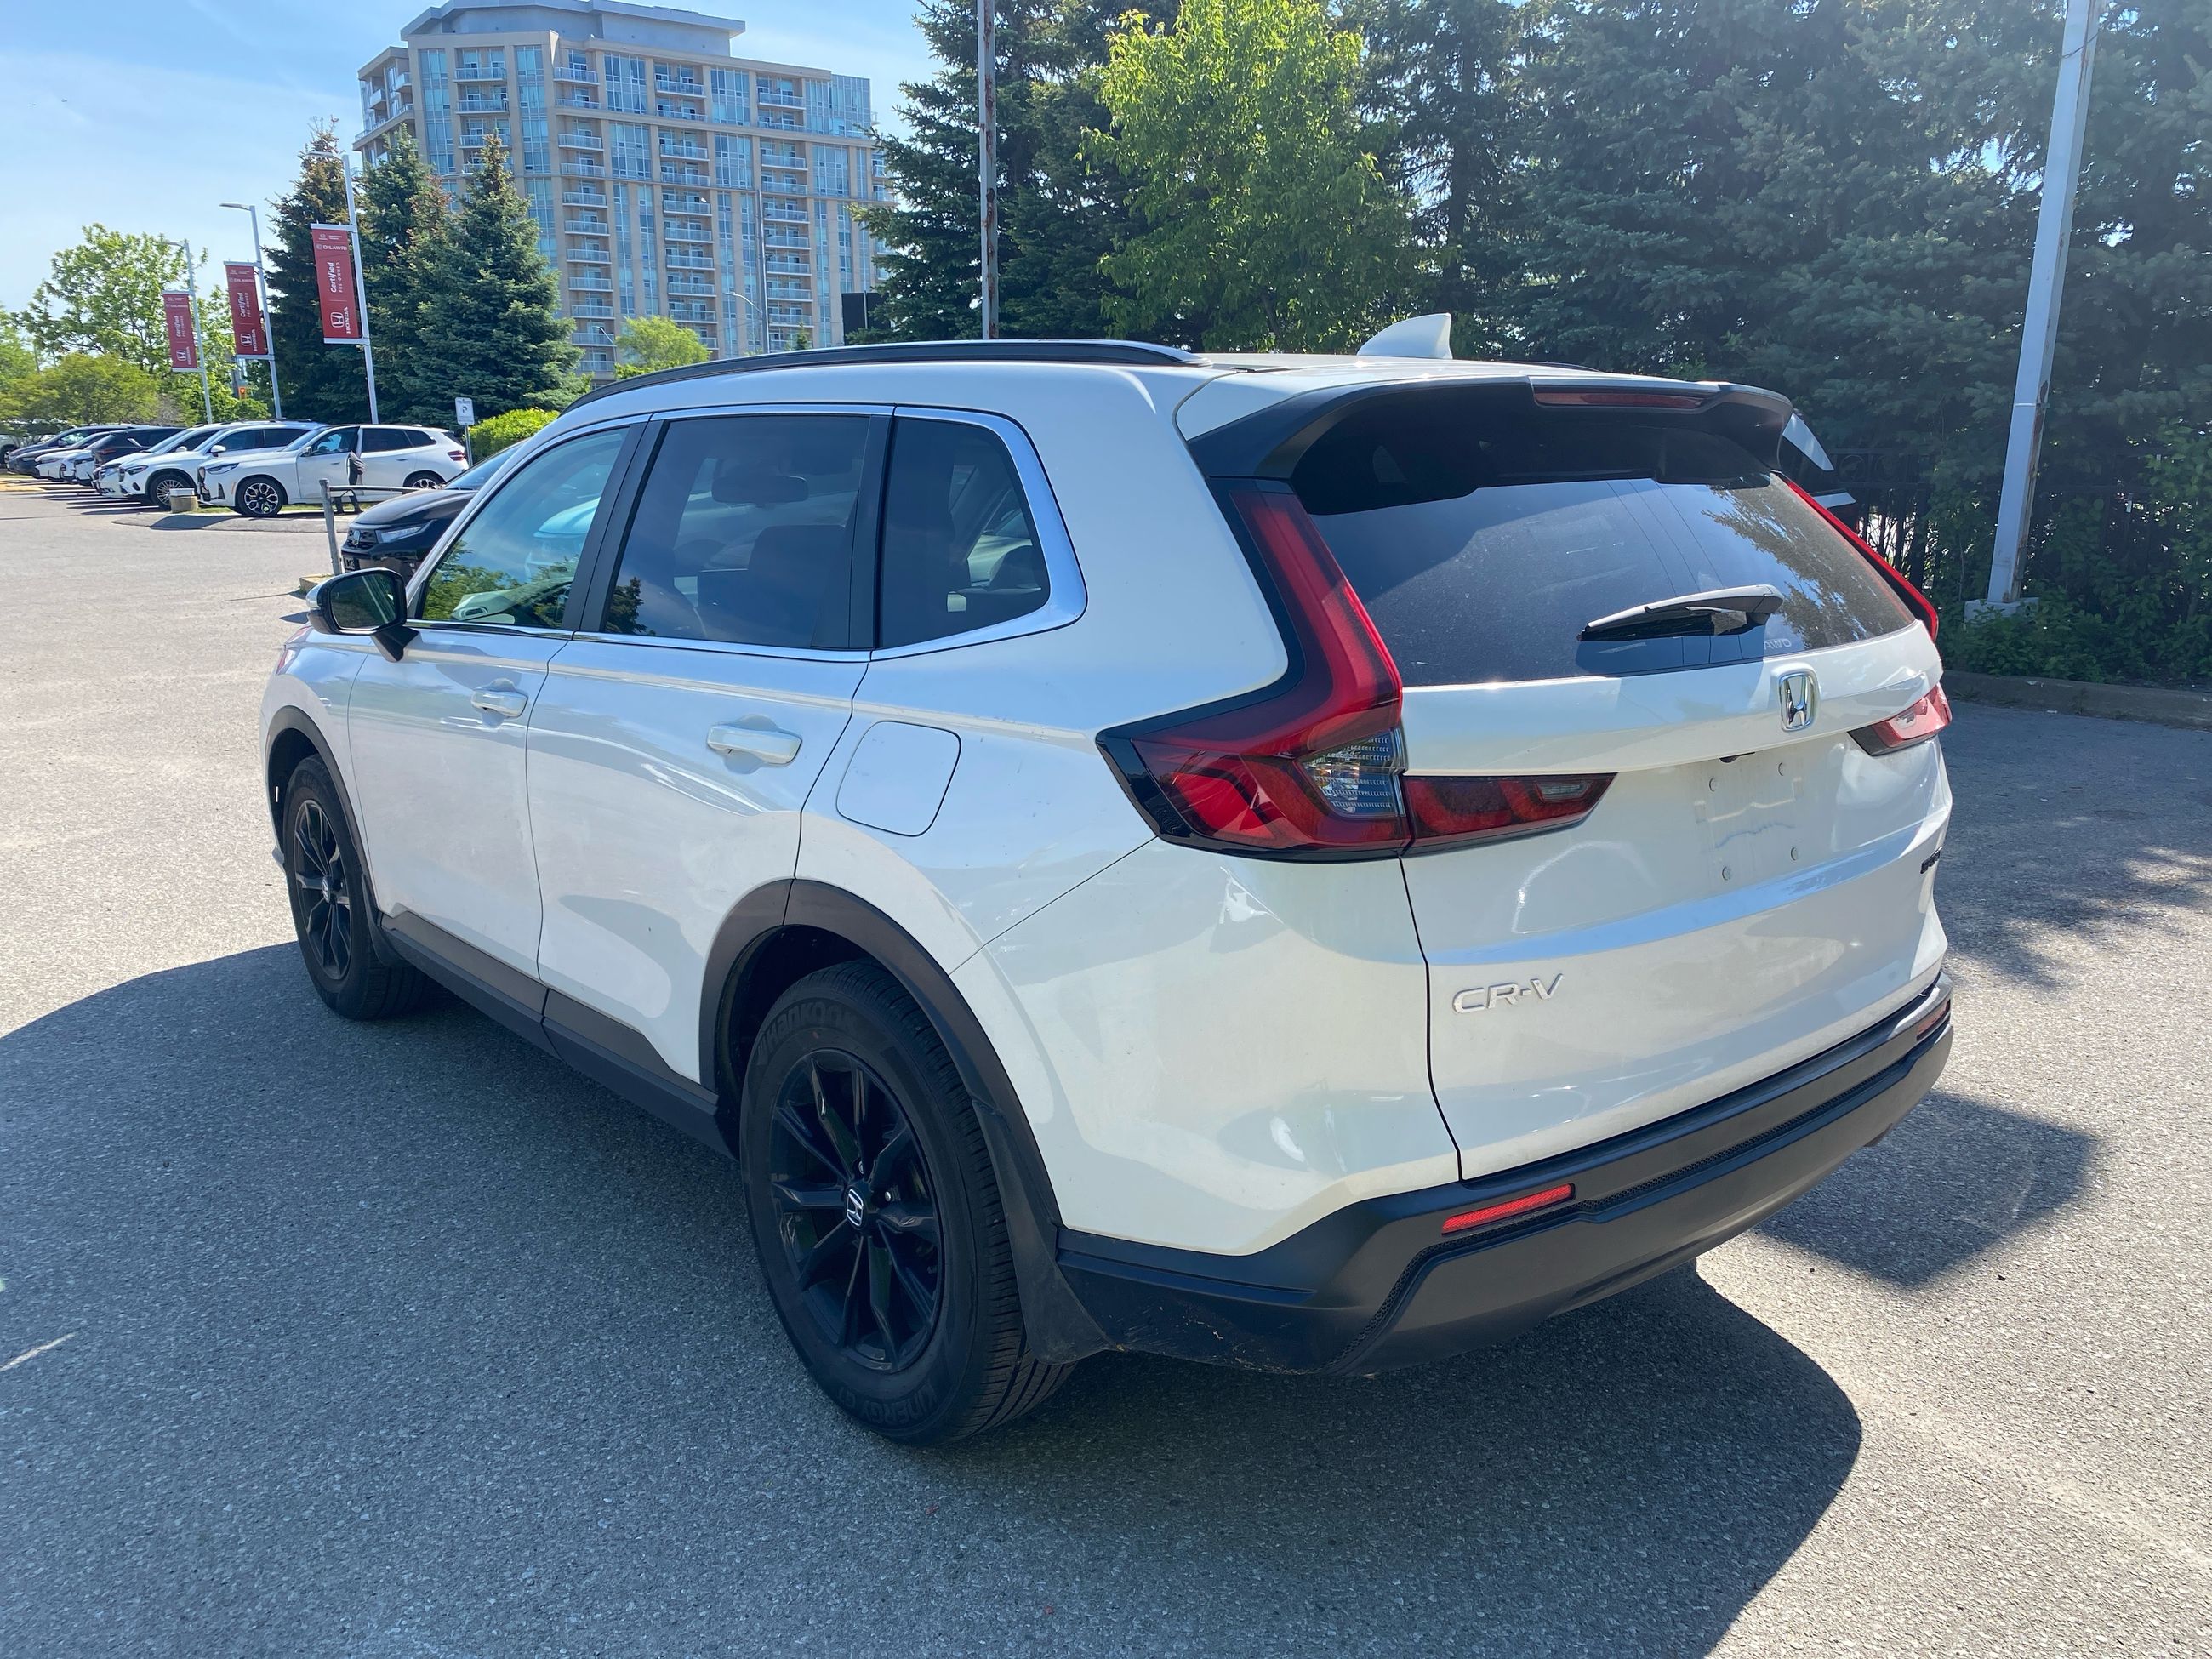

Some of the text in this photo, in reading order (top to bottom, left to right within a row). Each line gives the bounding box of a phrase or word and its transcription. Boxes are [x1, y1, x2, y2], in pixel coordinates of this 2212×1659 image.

[327, 261, 337, 294] Certified
[237, 292, 246, 317] Certified
[343, 306, 351, 334] HONDA
[1764, 638, 1792, 650] AWD
[1452, 972, 1565, 1014] CR-V
